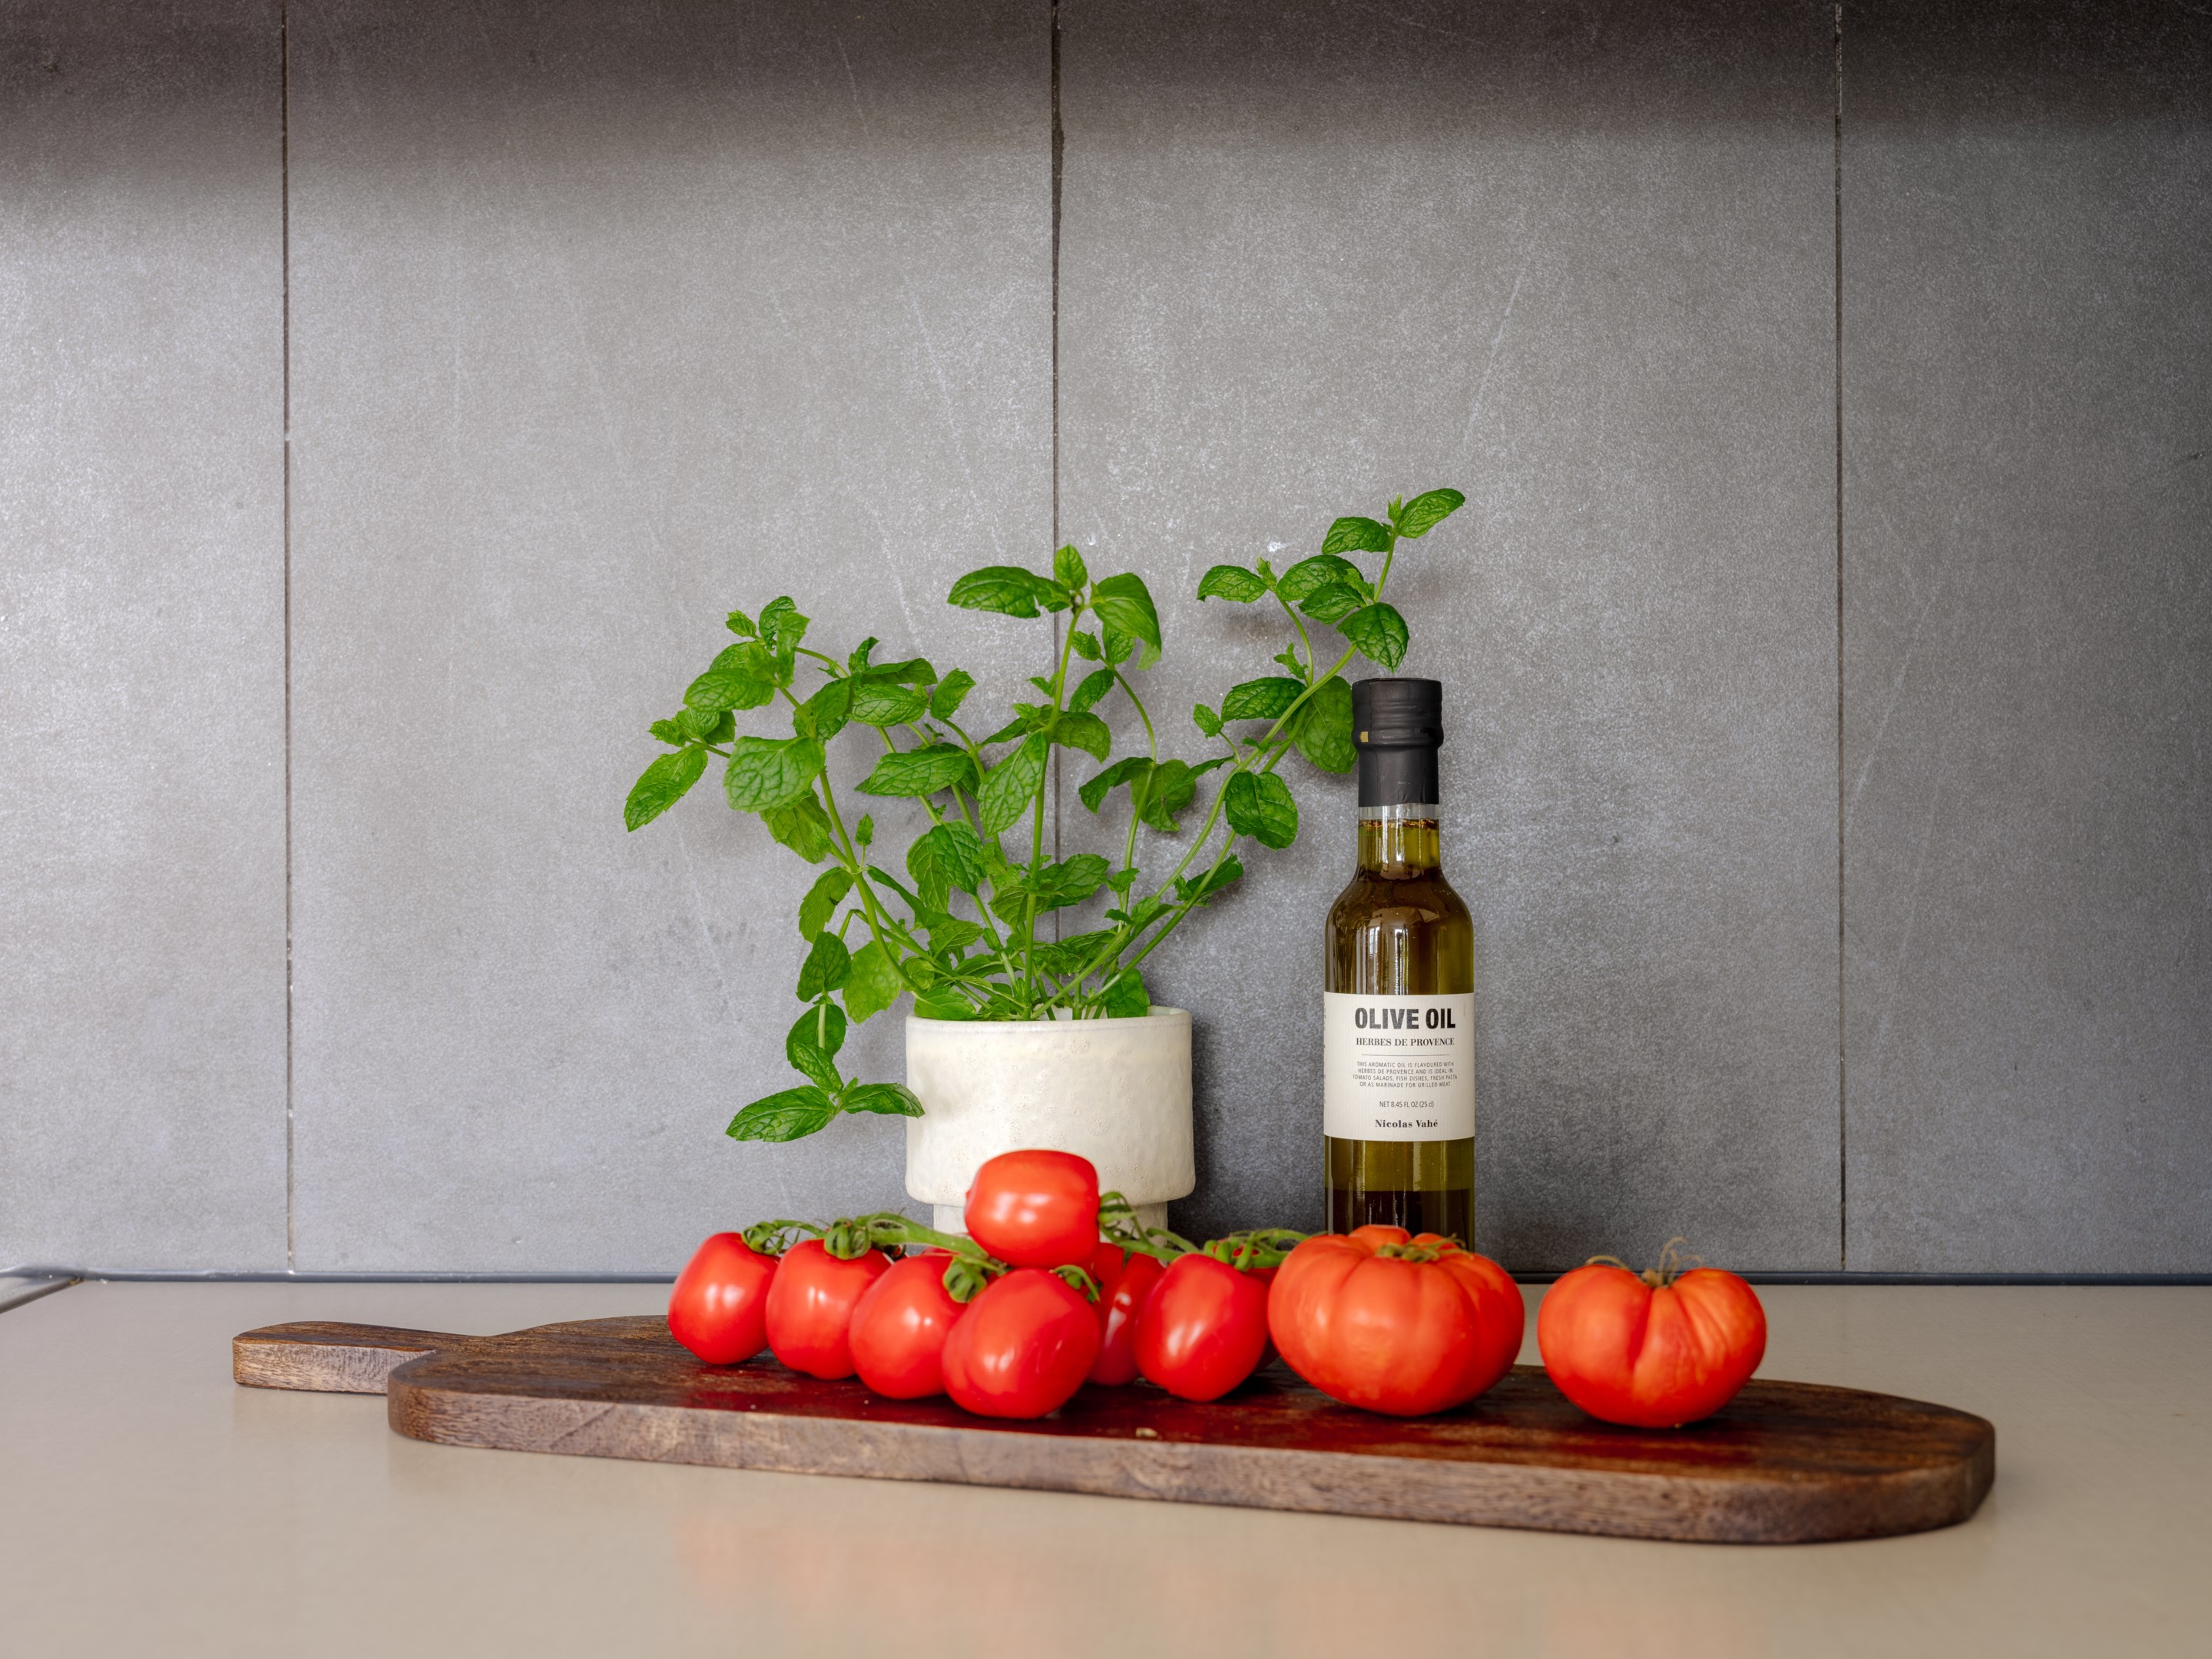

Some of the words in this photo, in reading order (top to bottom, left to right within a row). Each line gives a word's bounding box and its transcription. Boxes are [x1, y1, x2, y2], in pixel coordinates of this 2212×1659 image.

[1355, 1008, 1419, 1030] OLIVE
[1426, 1008, 1456, 1029] OIL
[1356, 1037, 1391, 1046] HERBES
[1411, 1038, 1454, 1046] PROVENCE
[1375, 1119, 1412, 1128] Nicolas
